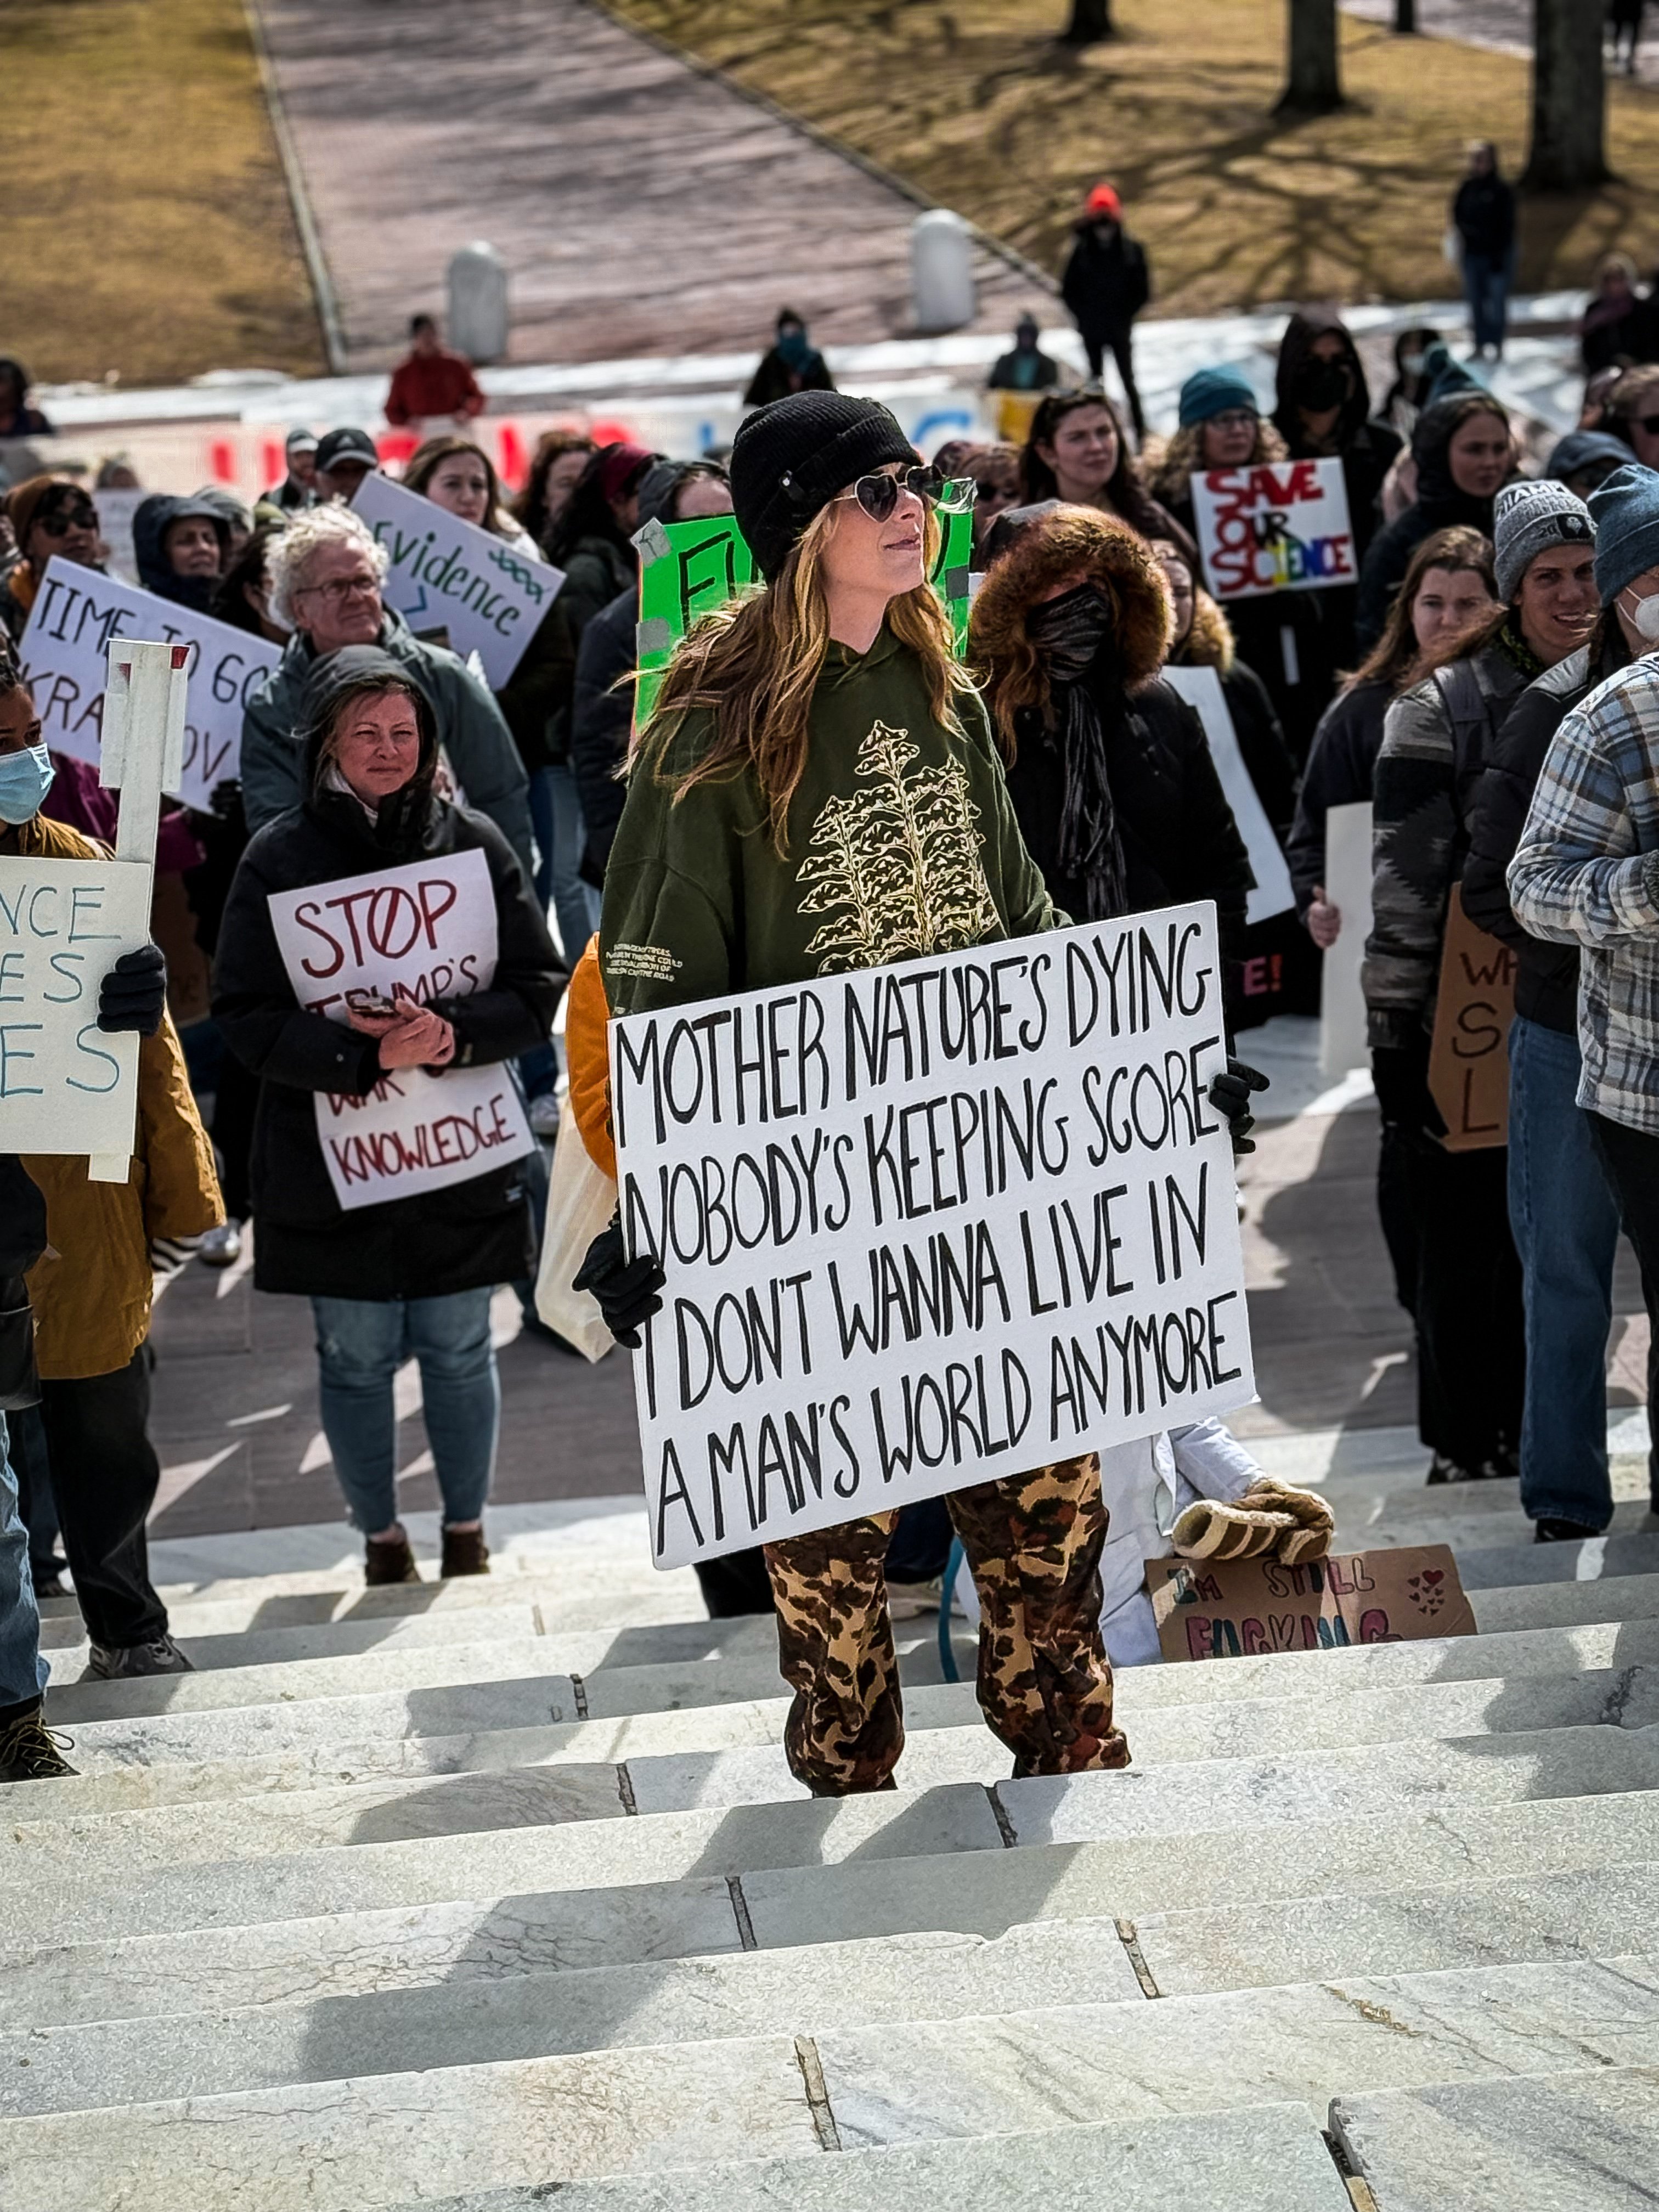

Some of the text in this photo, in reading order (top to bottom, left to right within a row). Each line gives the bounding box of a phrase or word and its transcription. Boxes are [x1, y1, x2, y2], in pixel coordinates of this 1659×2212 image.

[1205, 460, 1324, 507] SAVE
[1209, 535, 1352, 592] SCIENCE
[295, 879, 457, 979] STOP
[616, 922, 1213, 1149] MOTHER NATURE'S DYING
[330, 1094, 516, 1185] KNOWLEDGE
[625, 1035, 1220, 1266] NOBODY'S KEEPING SCORE
[676, 1269, 813, 1413] DON'T
[830, 1219, 1011, 1361] WANNA
[1020, 1184, 1134, 1316] LIVE
[1149, 1161, 1209, 1285] IN
[657, 1290, 1242, 1557] A MAN'S WORLD ANYMORE
[1262, 1557, 1376, 1598] STILL
